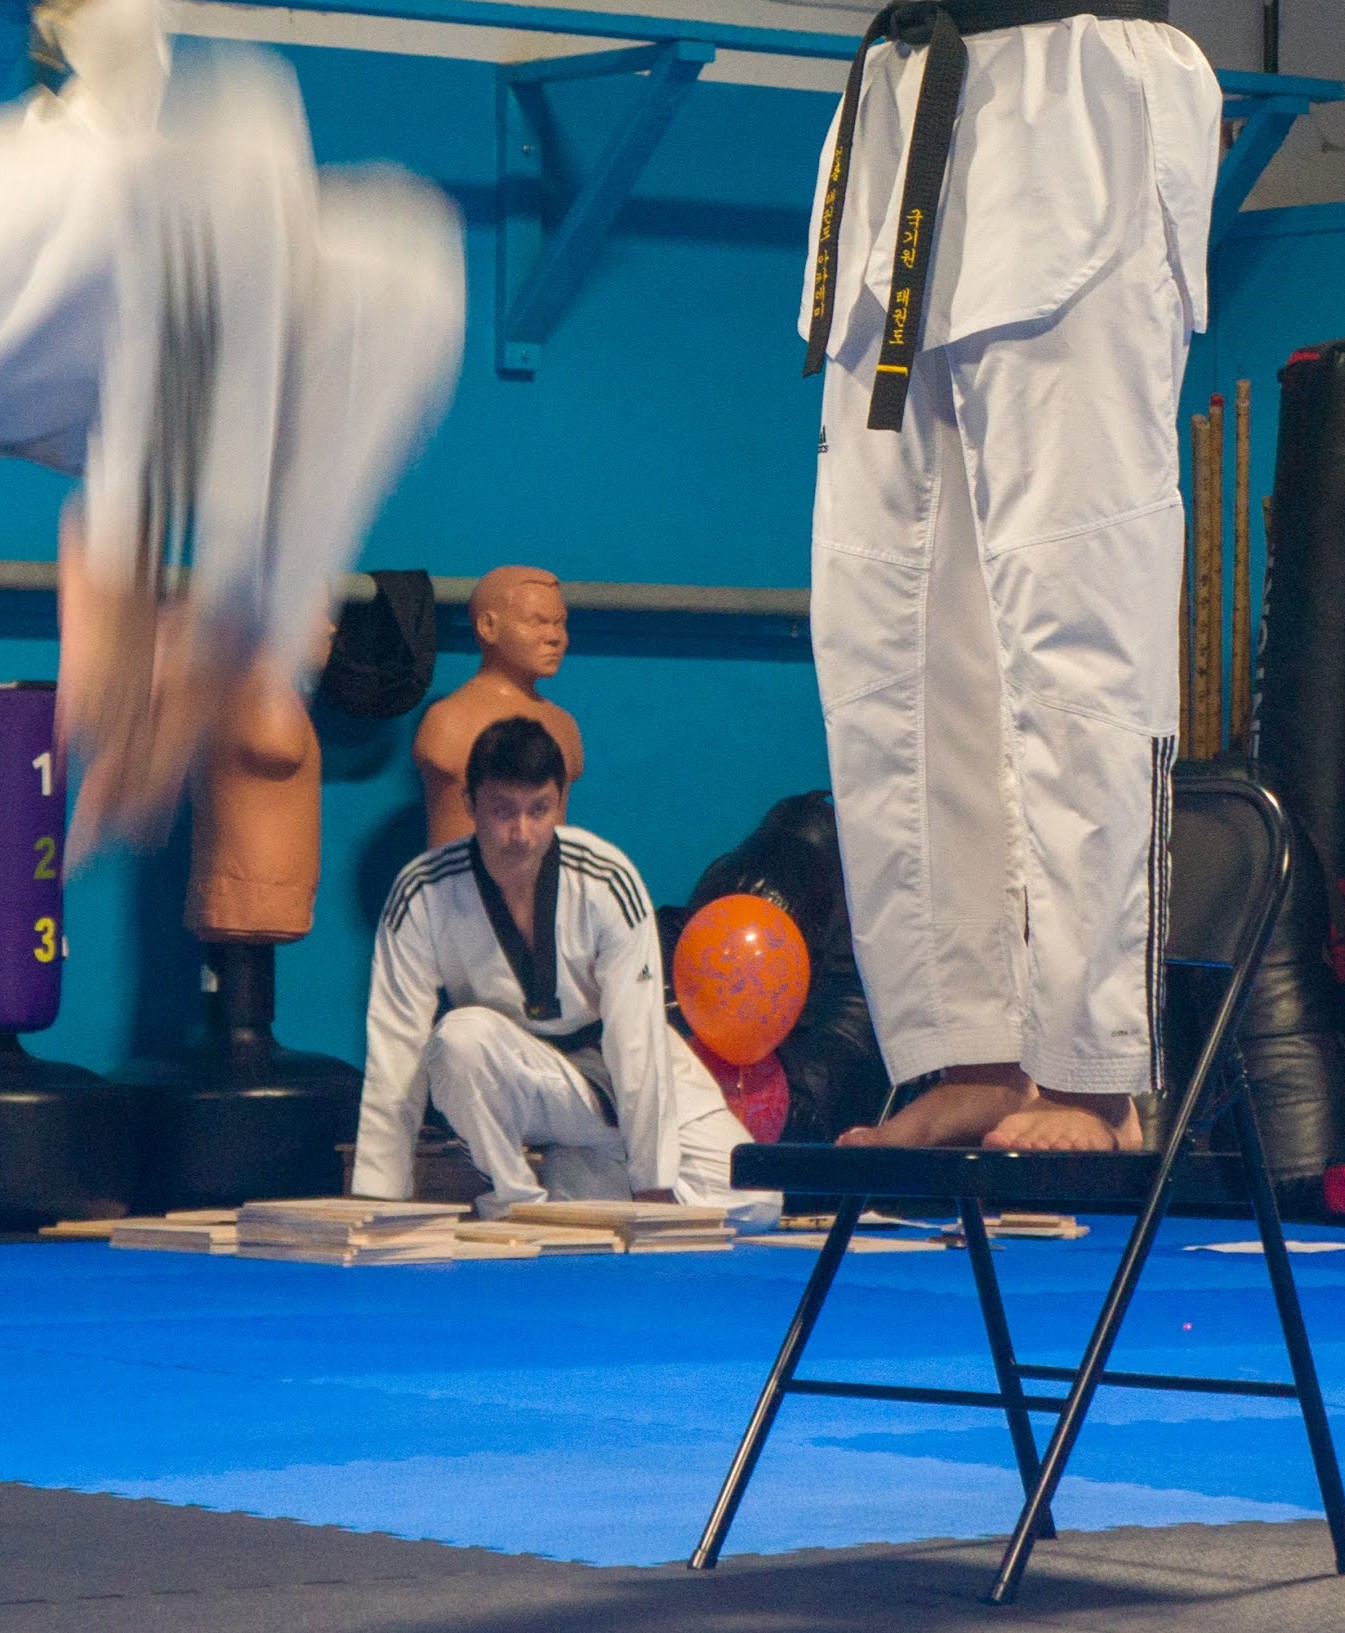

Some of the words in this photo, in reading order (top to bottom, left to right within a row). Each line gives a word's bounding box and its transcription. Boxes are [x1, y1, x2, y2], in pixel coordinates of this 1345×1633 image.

[889, 287, 911, 345] 태권도
[32, 752, 52, 796] 1
[33, 837, 55, 879] 2
[33, 917, 55, 962] 3
